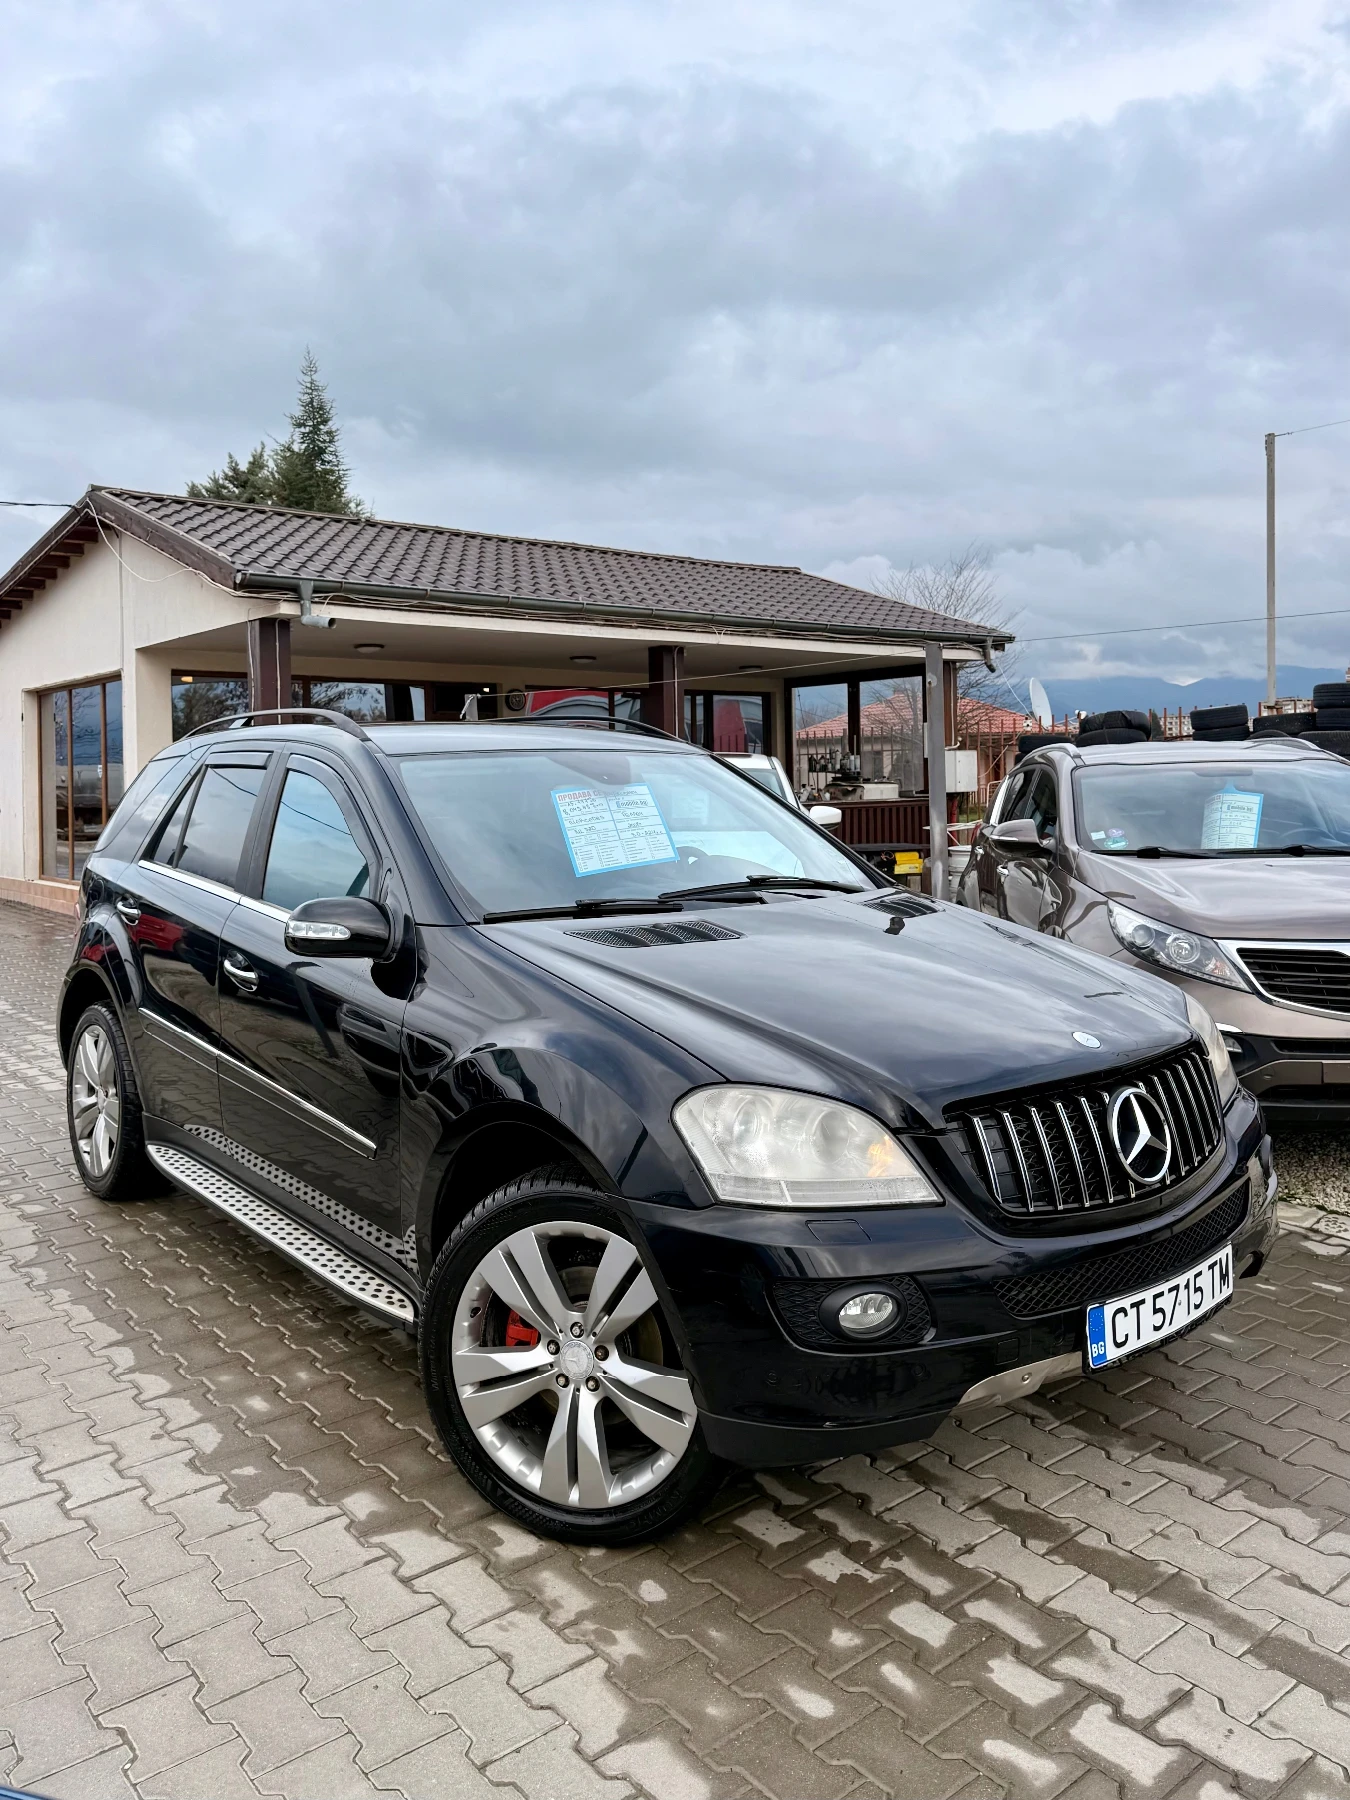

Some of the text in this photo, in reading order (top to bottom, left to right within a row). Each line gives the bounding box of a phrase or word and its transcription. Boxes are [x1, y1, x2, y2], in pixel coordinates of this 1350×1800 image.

[557, 790, 592, 802] ПРОДАВА
[1111, 1252, 1230, 1349] CT 5715 TM
[1091, 1341, 1105, 1357] BG
